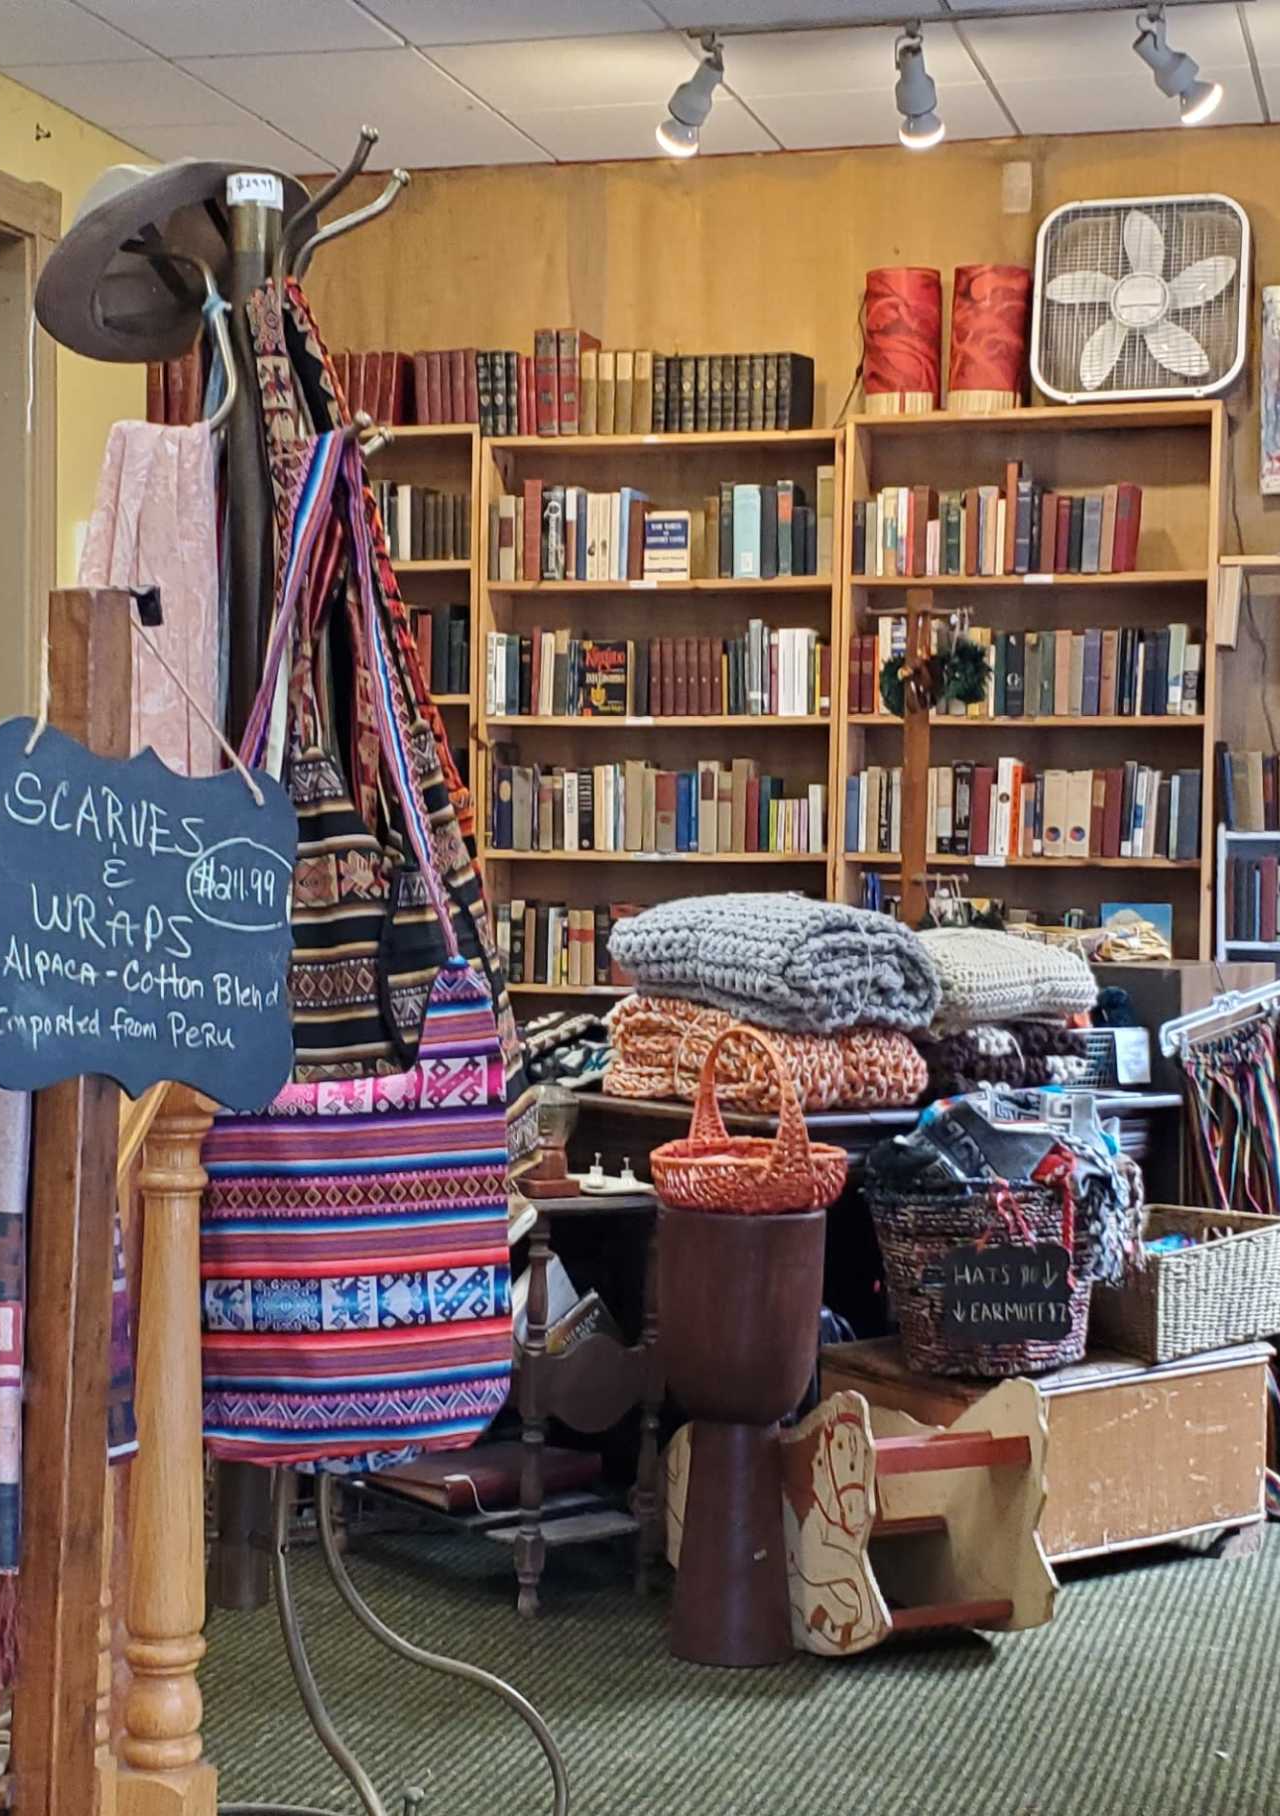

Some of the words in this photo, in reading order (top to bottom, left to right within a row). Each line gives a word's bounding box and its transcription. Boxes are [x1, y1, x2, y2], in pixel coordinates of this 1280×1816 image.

[4, 771, 207, 858] SCARVES
[31, 882, 195, 960] WRAPS
[212, 972, 280, 1014] Blend
[952, 1263, 1011, 1288] HATS
